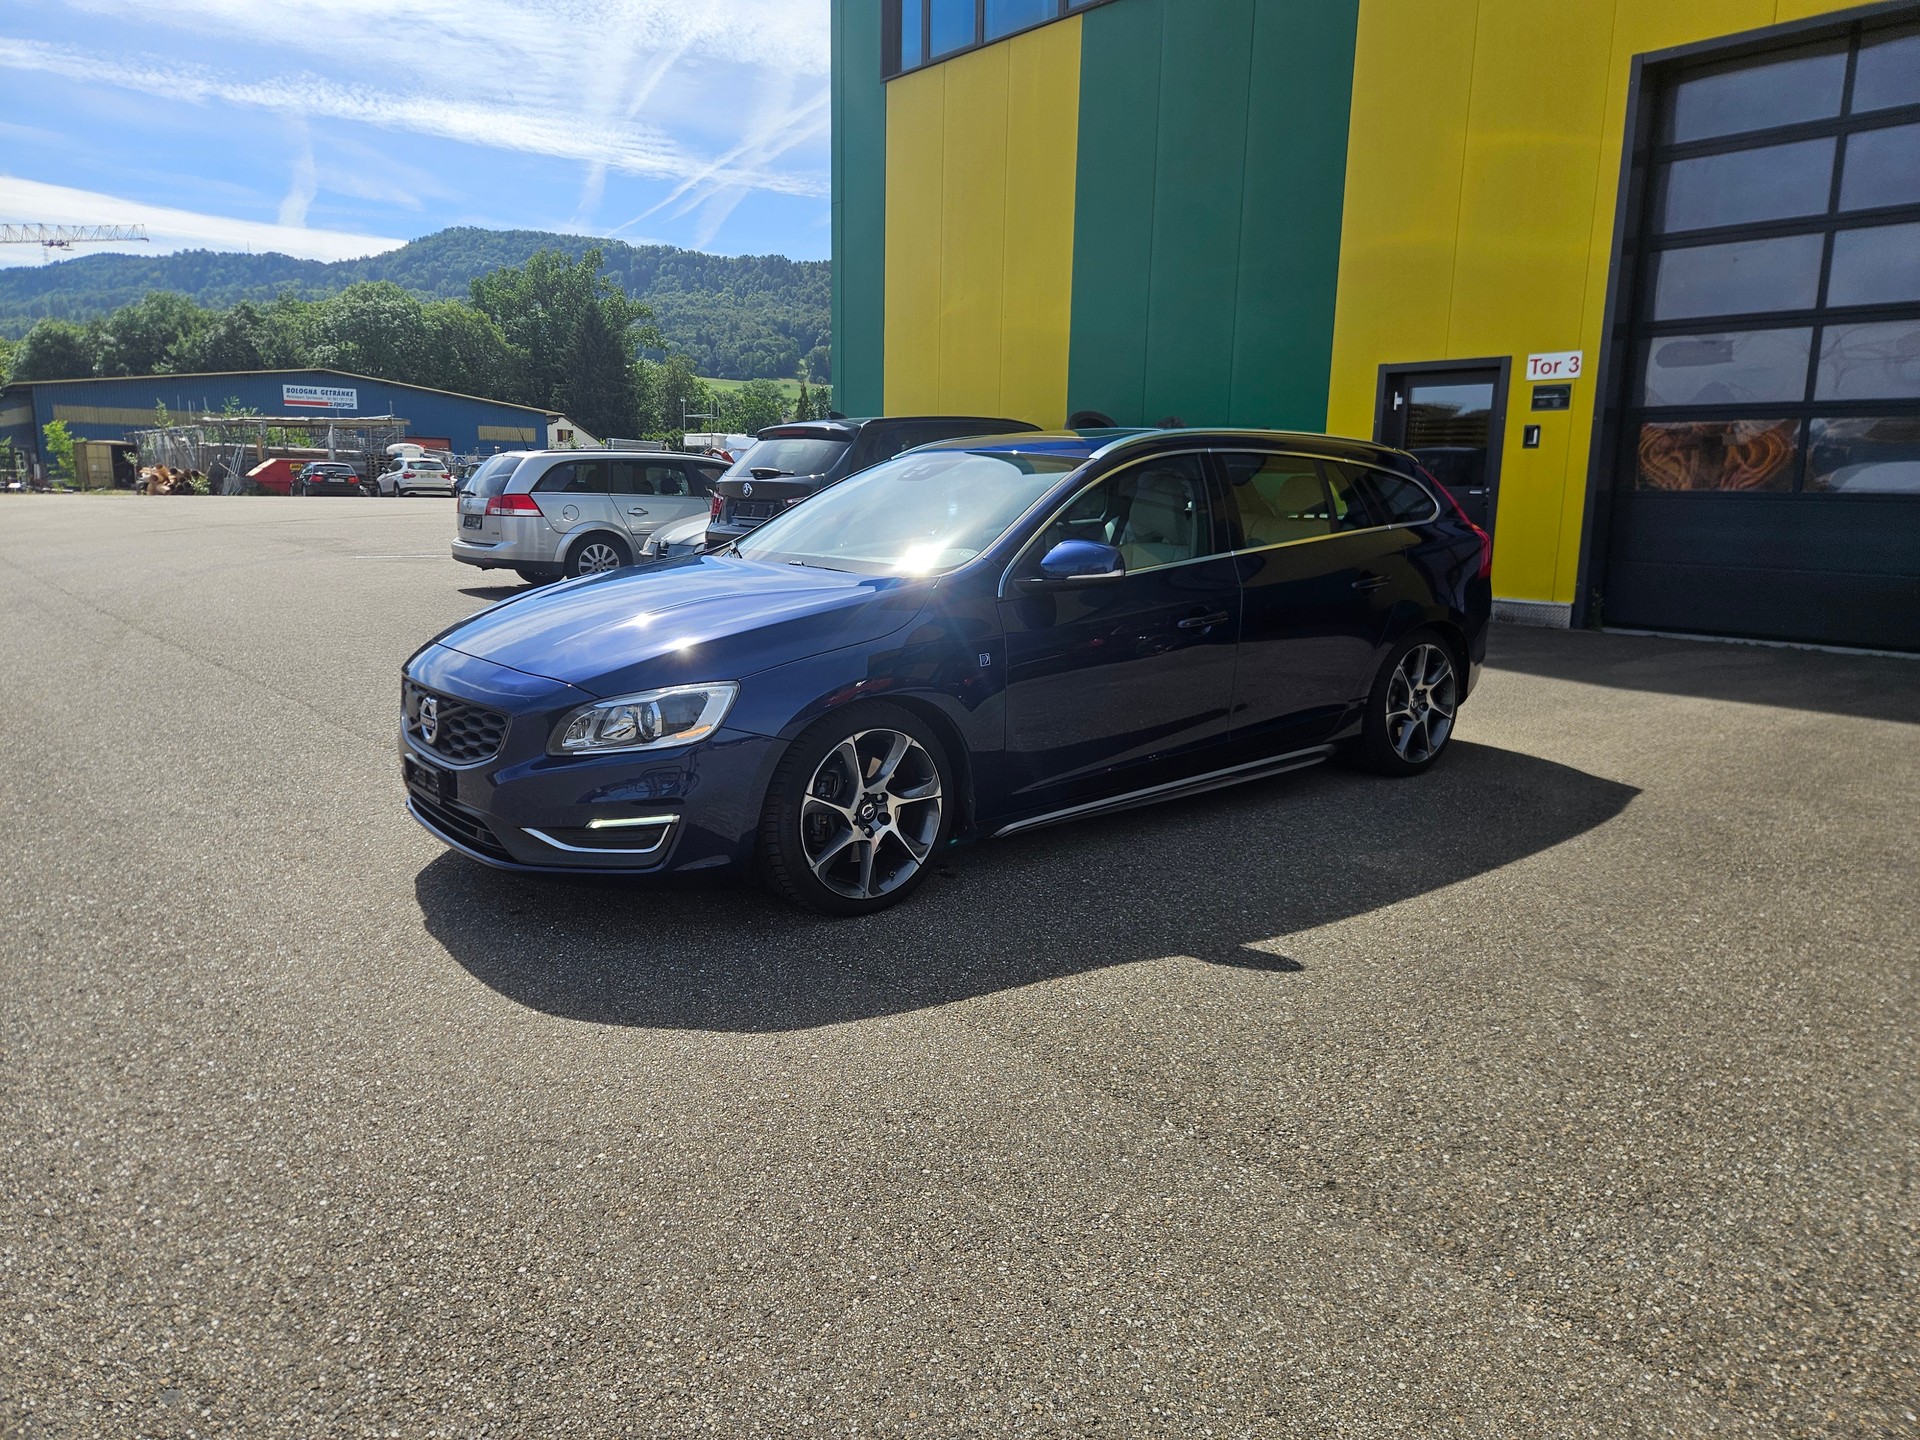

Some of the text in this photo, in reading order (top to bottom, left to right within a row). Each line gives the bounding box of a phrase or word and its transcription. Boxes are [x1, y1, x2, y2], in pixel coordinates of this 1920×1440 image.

[1529, 356, 1580, 375] Tor 3
[286, 387, 317, 395] BOLOGNA
